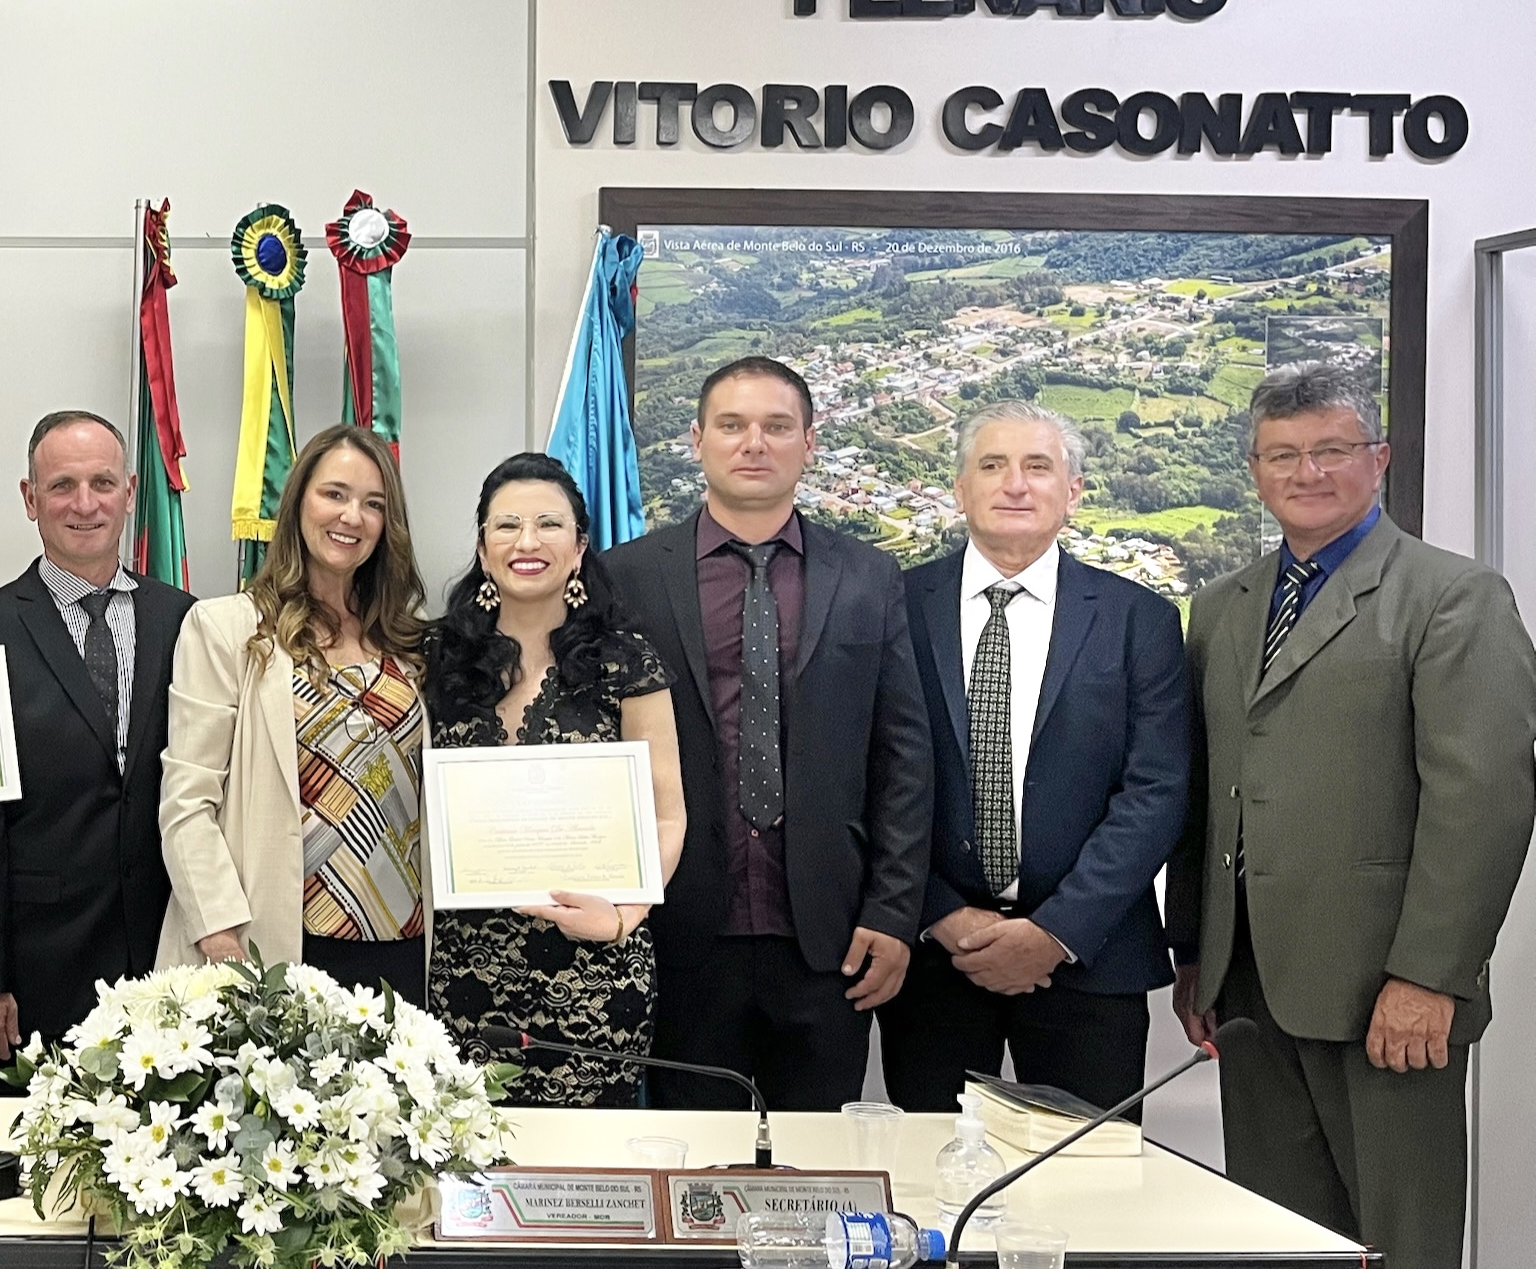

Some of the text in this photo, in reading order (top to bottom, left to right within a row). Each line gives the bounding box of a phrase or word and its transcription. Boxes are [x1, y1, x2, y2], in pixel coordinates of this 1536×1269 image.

[548, 80, 1469, 159] VITORIO CASONATTO
[664, 239, 690, 251] Vista
[692, 239, 724, 251] Aérea
[726, 239, 741, 251] de
[744, 240, 779, 252] Monte
[782, 241, 806, 252] Belo
[808, 241, 822, 252] do
[825, 241, 843, 252] Sul
[851, 242, 865, 253] RS
[886, 243, 900, 253] 20
[902, 242, 916, 253] de
[918, 242, 975, 253] Dezembro
[977, 243, 991, 253] de
[994, 243, 1022, 254] 2016
[513, 1182, 536, 1190] CÂMARA
[525, 1198, 645, 1209] MARINEZ BERSELLI ZANCHET
[765, 1196, 857, 1213] SECRETÁRIO (A)
